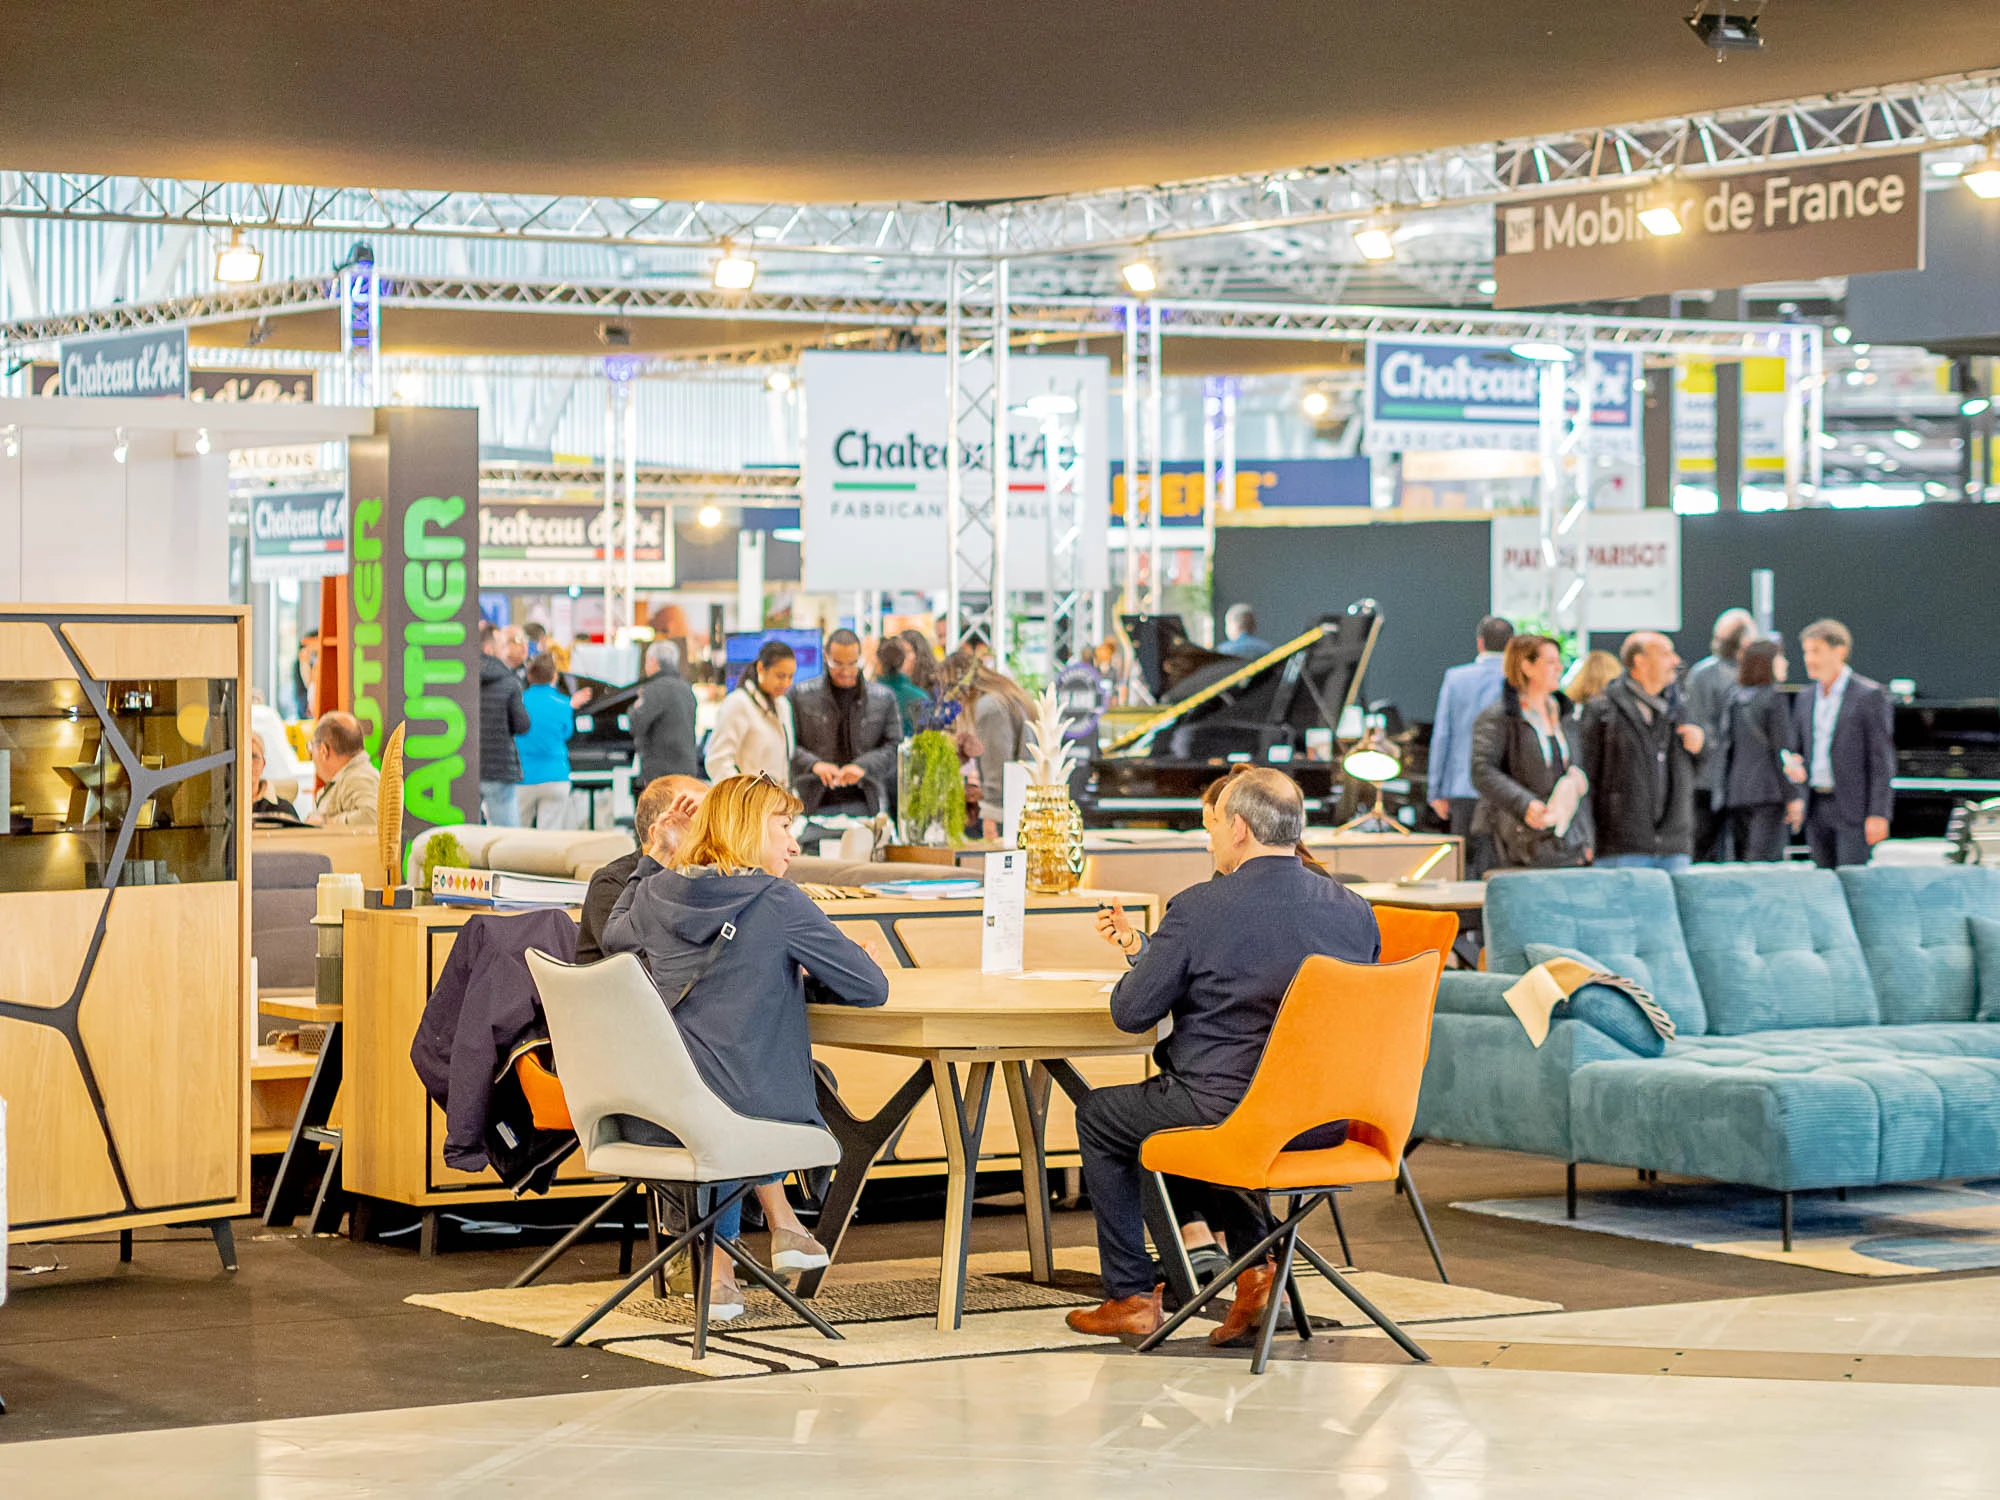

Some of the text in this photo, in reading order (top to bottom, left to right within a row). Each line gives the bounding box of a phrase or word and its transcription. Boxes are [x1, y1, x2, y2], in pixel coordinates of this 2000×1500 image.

[1543, 173, 1905, 250] Mobilr de France
[64, 352, 135, 397] Chateau
[136, 341, 181, 392] d'Axi
[1380, 350, 1540, 403] Chateau
[229, 451, 315, 468] ALONS
[479, 507, 586, 548] hateau
[831, 502, 943, 519] FABRICAN
[353, 497, 383, 758] UTIER
[403, 496, 467, 827] AUTIER
